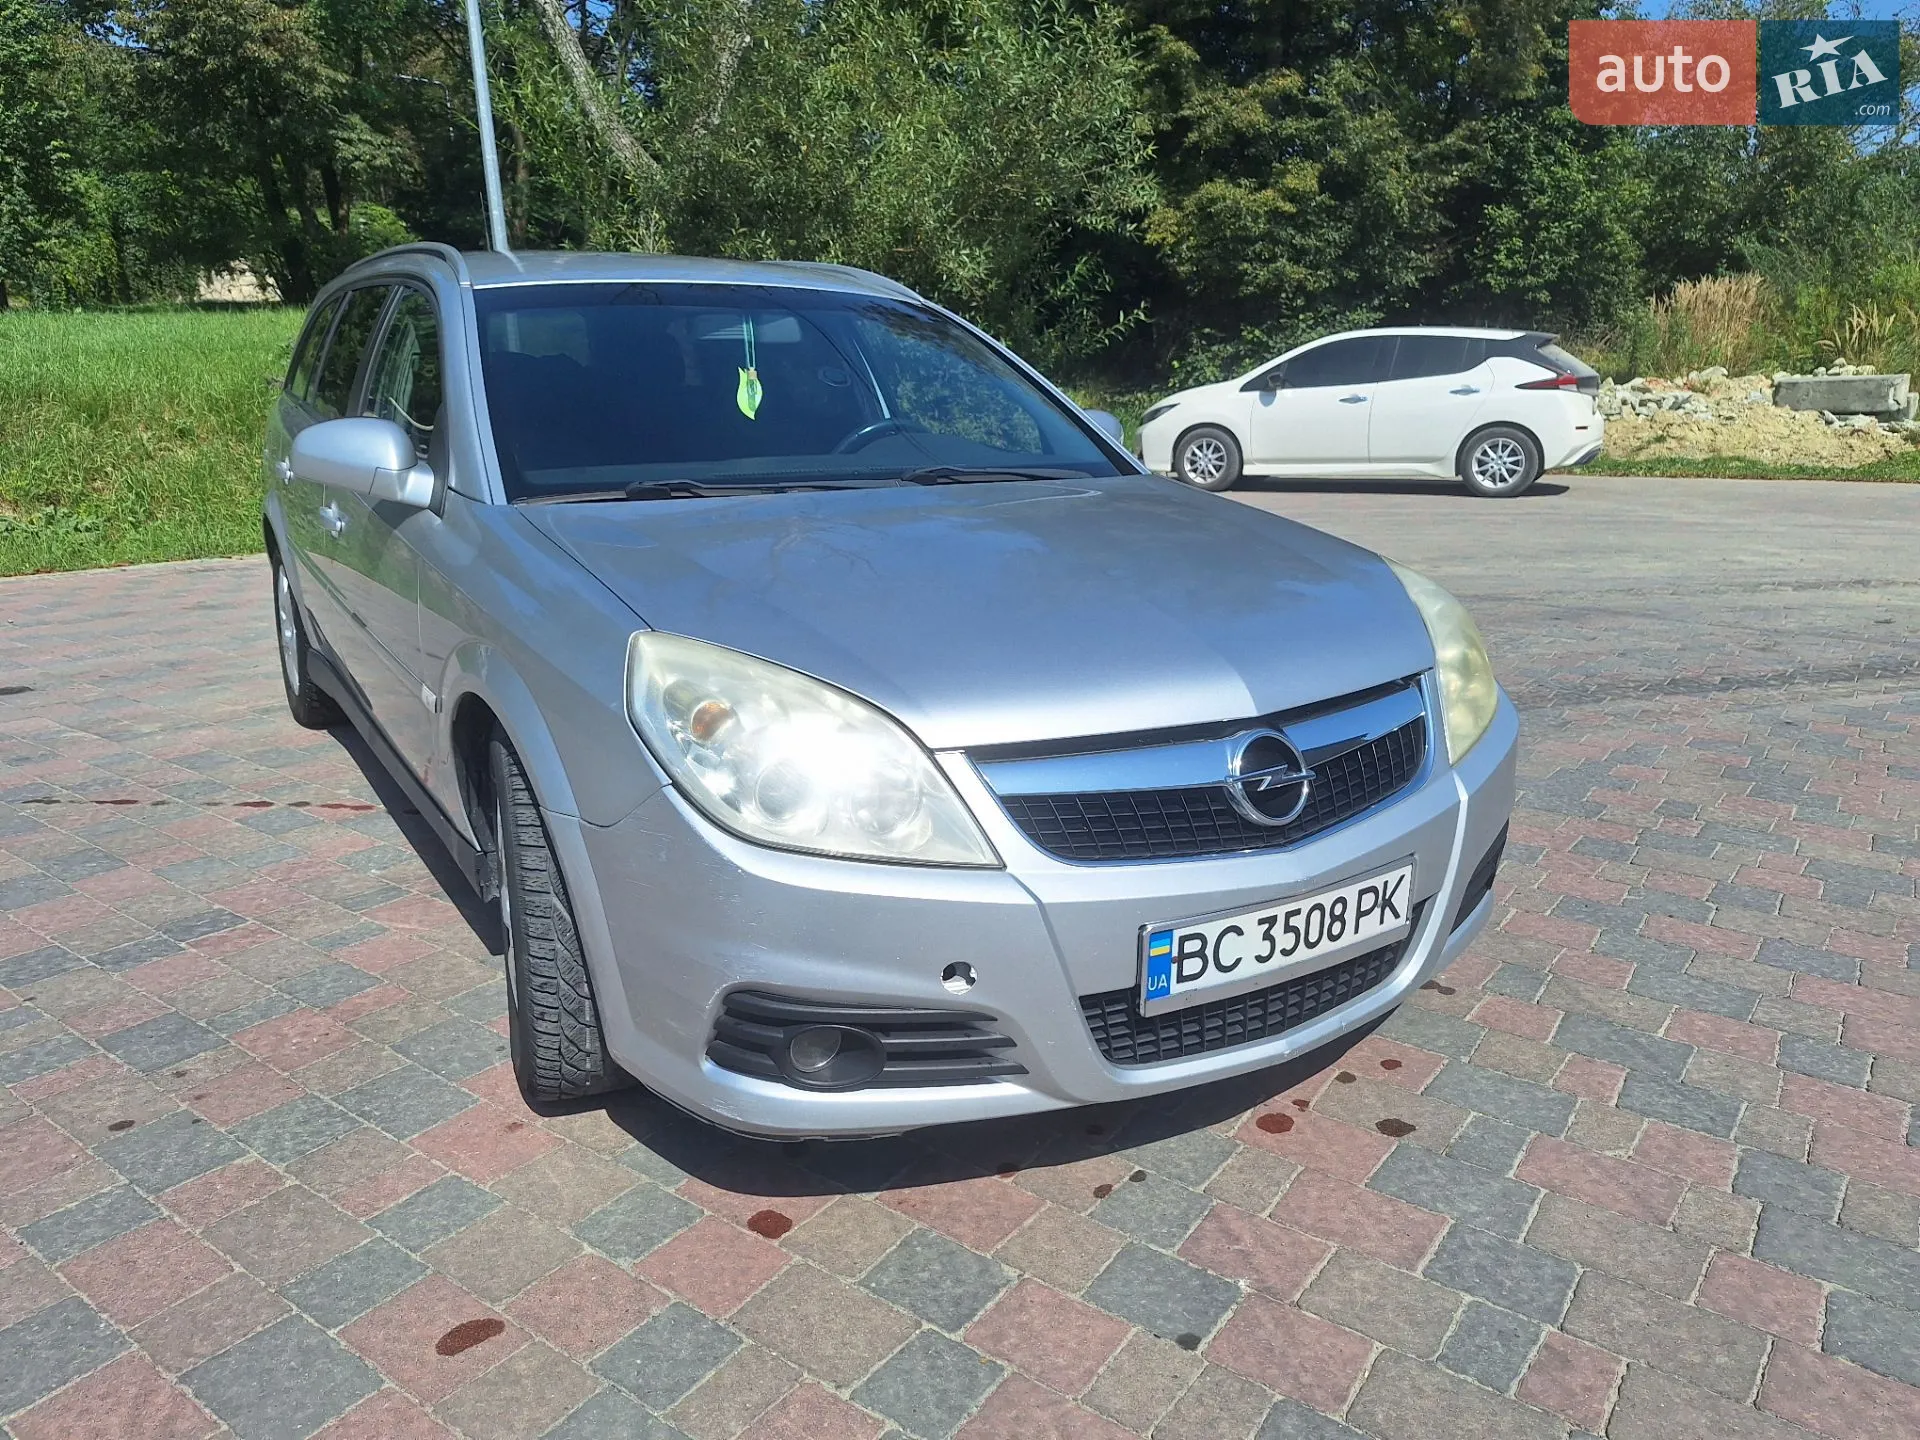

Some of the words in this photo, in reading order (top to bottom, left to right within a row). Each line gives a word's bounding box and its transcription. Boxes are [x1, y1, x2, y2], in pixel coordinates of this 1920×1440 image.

[1176, 924, 1244, 984] BC
[1254, 896, 1348, 964] 3508
[1353, 874, 1406, 935] PK
[1148, 974, 1168, 991] UA
